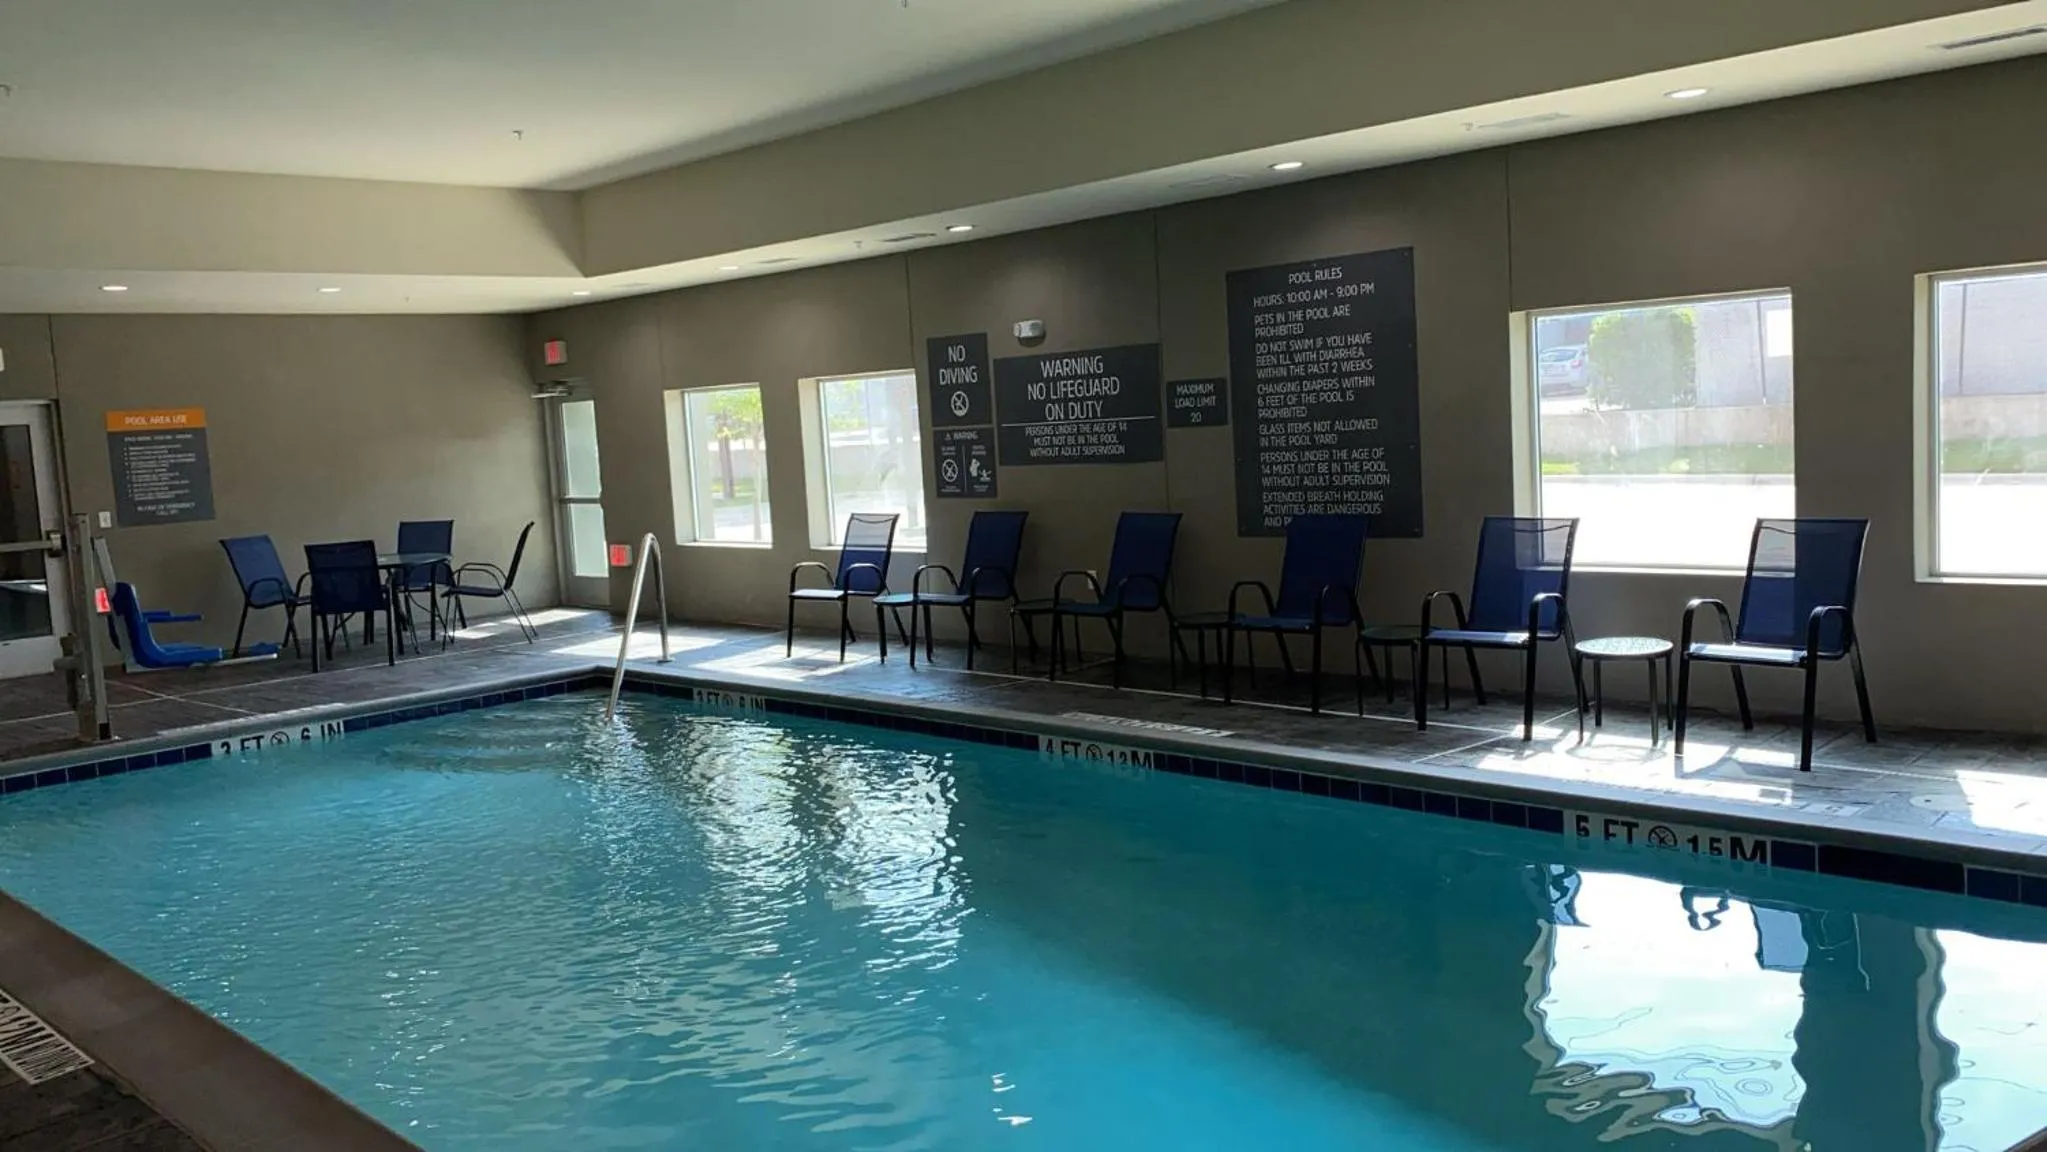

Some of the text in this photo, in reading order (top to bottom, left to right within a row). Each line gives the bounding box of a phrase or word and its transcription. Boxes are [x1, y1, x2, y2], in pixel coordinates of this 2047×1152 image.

[1288, 267, 1342, 284] POOL RULES
[1254, 294, 1284, 308] HOURS:
[1287, 291, 1311, 303] 10:00
[1313, 288, 1327, 300] AM
[1336, 286, 1358, 298] 9:00
[1360, 283, 1375, 295] PM
[1254, 304, 1351, 326] PETS IN THE POOL ARE
[1255, 324, 1304, 338] PROHIBITED
[1255, 333, 1372, 355] DO NOT SWIM IF YOU HAVE
[948, 345, 966, 363] NO
[1256, 347, 1365, 366] BEEN ILL WITH DIARRHEA
[939, 365, 978, 385] DIVING
[1041, 356, 1103, 378] WARNING
[1256, 359, 1373, 379] WITHIN THE PAST 2 WEEKS
[1027, 377, 1120, 401] NO LIFEGUARD
[1176, 383, 1214, 395] MAXIMUM
[1257, 376, 1375, 394] CHANGING DIAPERS WITHIN
[1175, 396, 1216, 409] LOAD LIMIT
[1257, 390, 1354, 407] 6 FEET OF THE POOL IS
[1045, 401, 1103, 420] ON DUTY
[1191, 413, 1202, 423] 20
[1258, 406, 1307, 419] PROHIBITED
[1025, 422, 1127, 436] PERSONS UNDER THE AGE OF 14
[1259, 418, 1378, 435] GLASS ITEMS NOT ALLOWED
[1260, 432, 1338, 447] IN THE POOL YARD
[1030, 445, 1125, 457] WITHOUT ADULT SUPERVISION
[1260, 448, 1385, 463] PERSONS UNDER THE AGE OF
[1262, 460, 1388, 475] 14 MUST NOT BE IN THE POOL
[1262, 473, 1391, 487] WITHOUT ADULT SUPERVISION
[1263, 490, 1383, 502] EXTENDED BREATH HOLDING
[1263, 503, 1381, 515] ACTIVITIES ARE DANGEROUS
[1264, 516, 1281, 527] AND
[240, 735, 265, 752] FT
[320, 721, 341, 739] IN
[1060, 741, 1081, 759] FT
[1575, 814, 1590, 837] 5
[1604, 818, 1639, 845] FT
